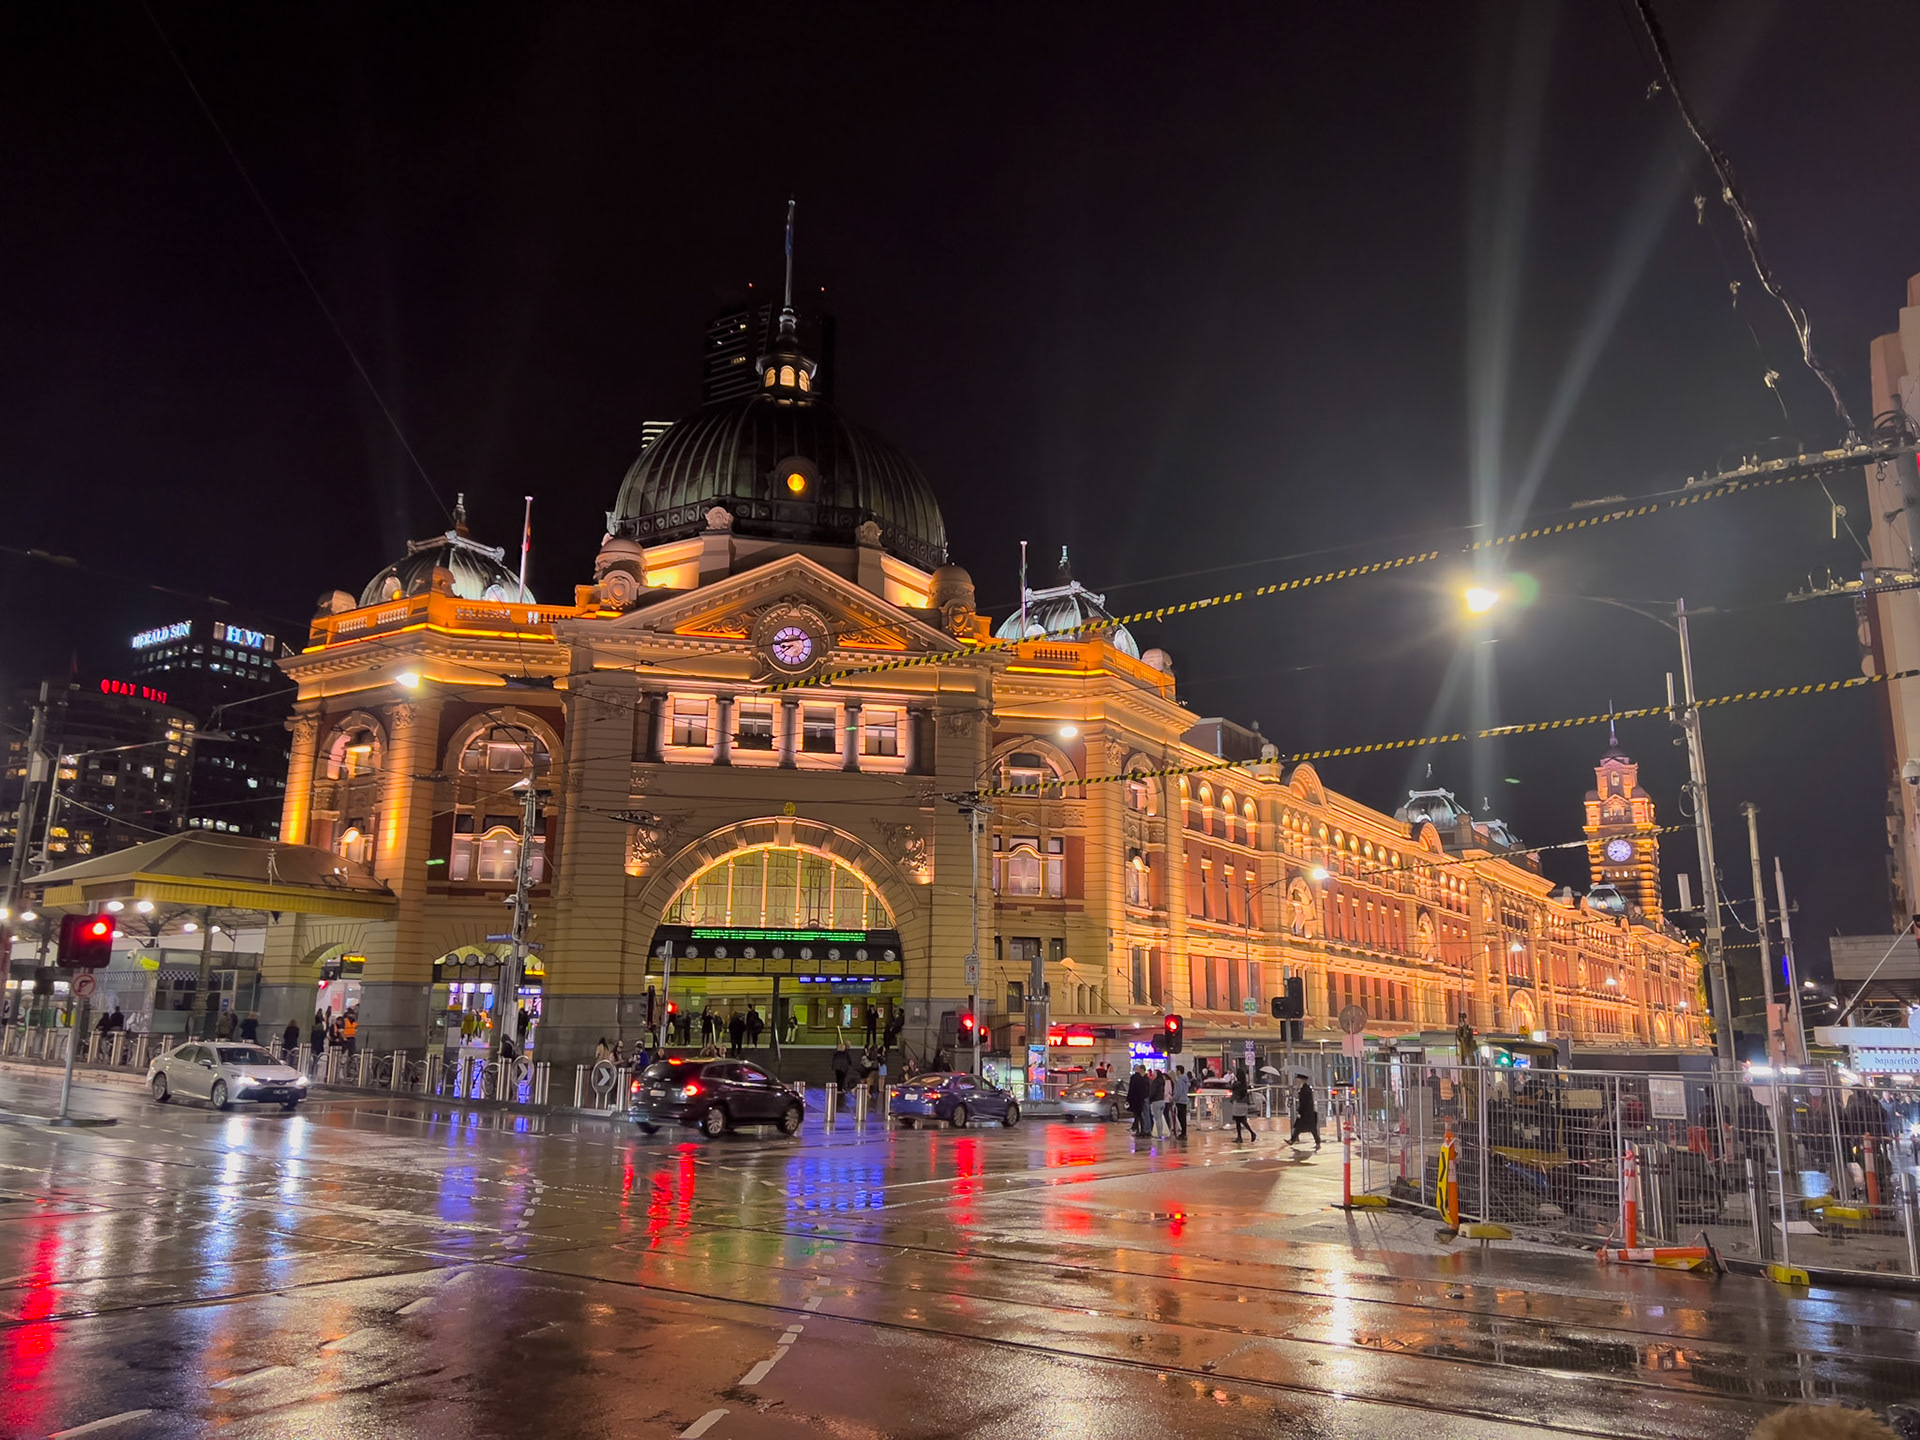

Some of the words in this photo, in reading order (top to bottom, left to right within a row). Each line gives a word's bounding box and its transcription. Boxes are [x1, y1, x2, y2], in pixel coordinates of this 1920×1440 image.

[131, 629, 169, 649] HERALD
[170, 623, 191, 639] SUN
[100, 679, 136, 696] QUAY
[142, 686, 167, 704] WEST
